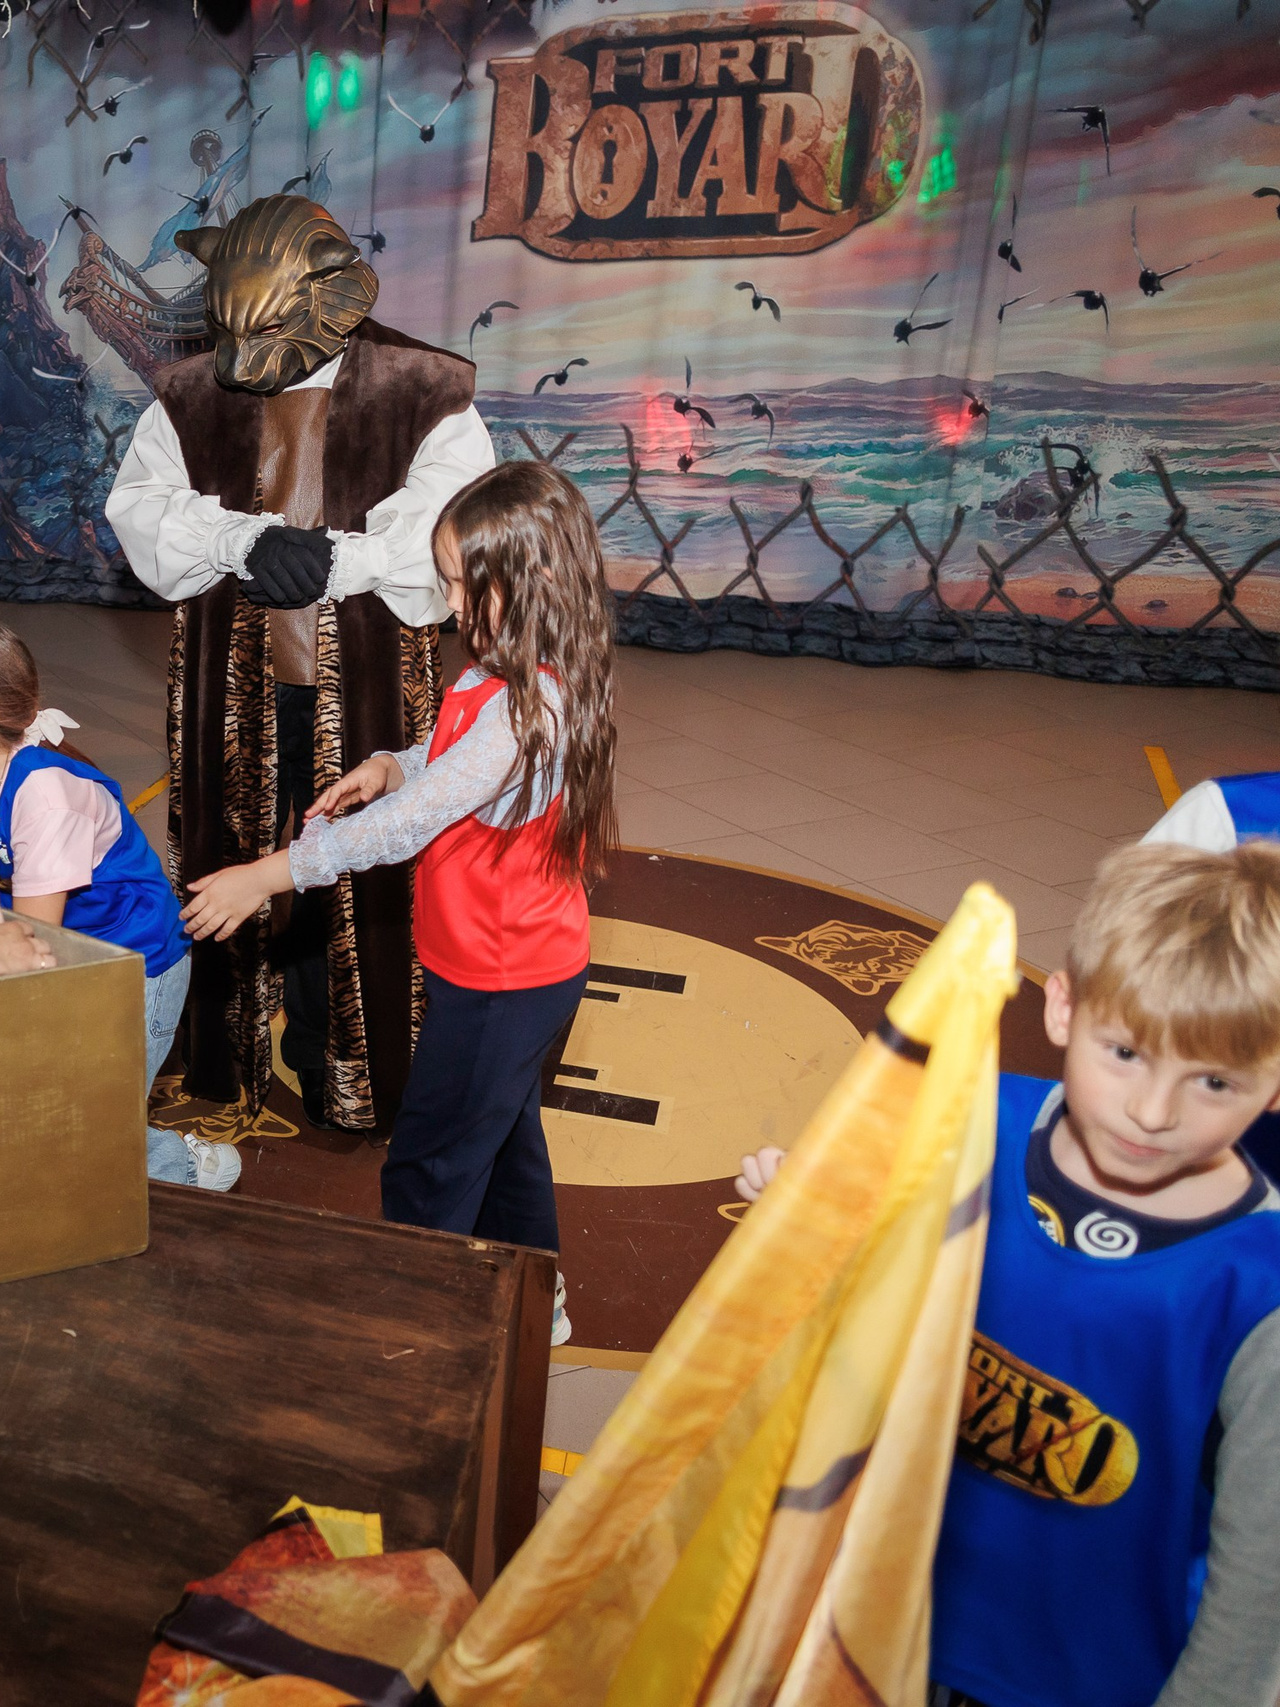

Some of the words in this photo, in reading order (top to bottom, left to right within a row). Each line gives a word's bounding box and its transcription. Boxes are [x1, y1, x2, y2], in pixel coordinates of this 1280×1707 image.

[593, 36, 804, 95] FORT
[471, 8, 922, 258] BOYARD
[969, 1346, 1054, 1408] ORT
[956, 1368, 1139, 1507] YARD
